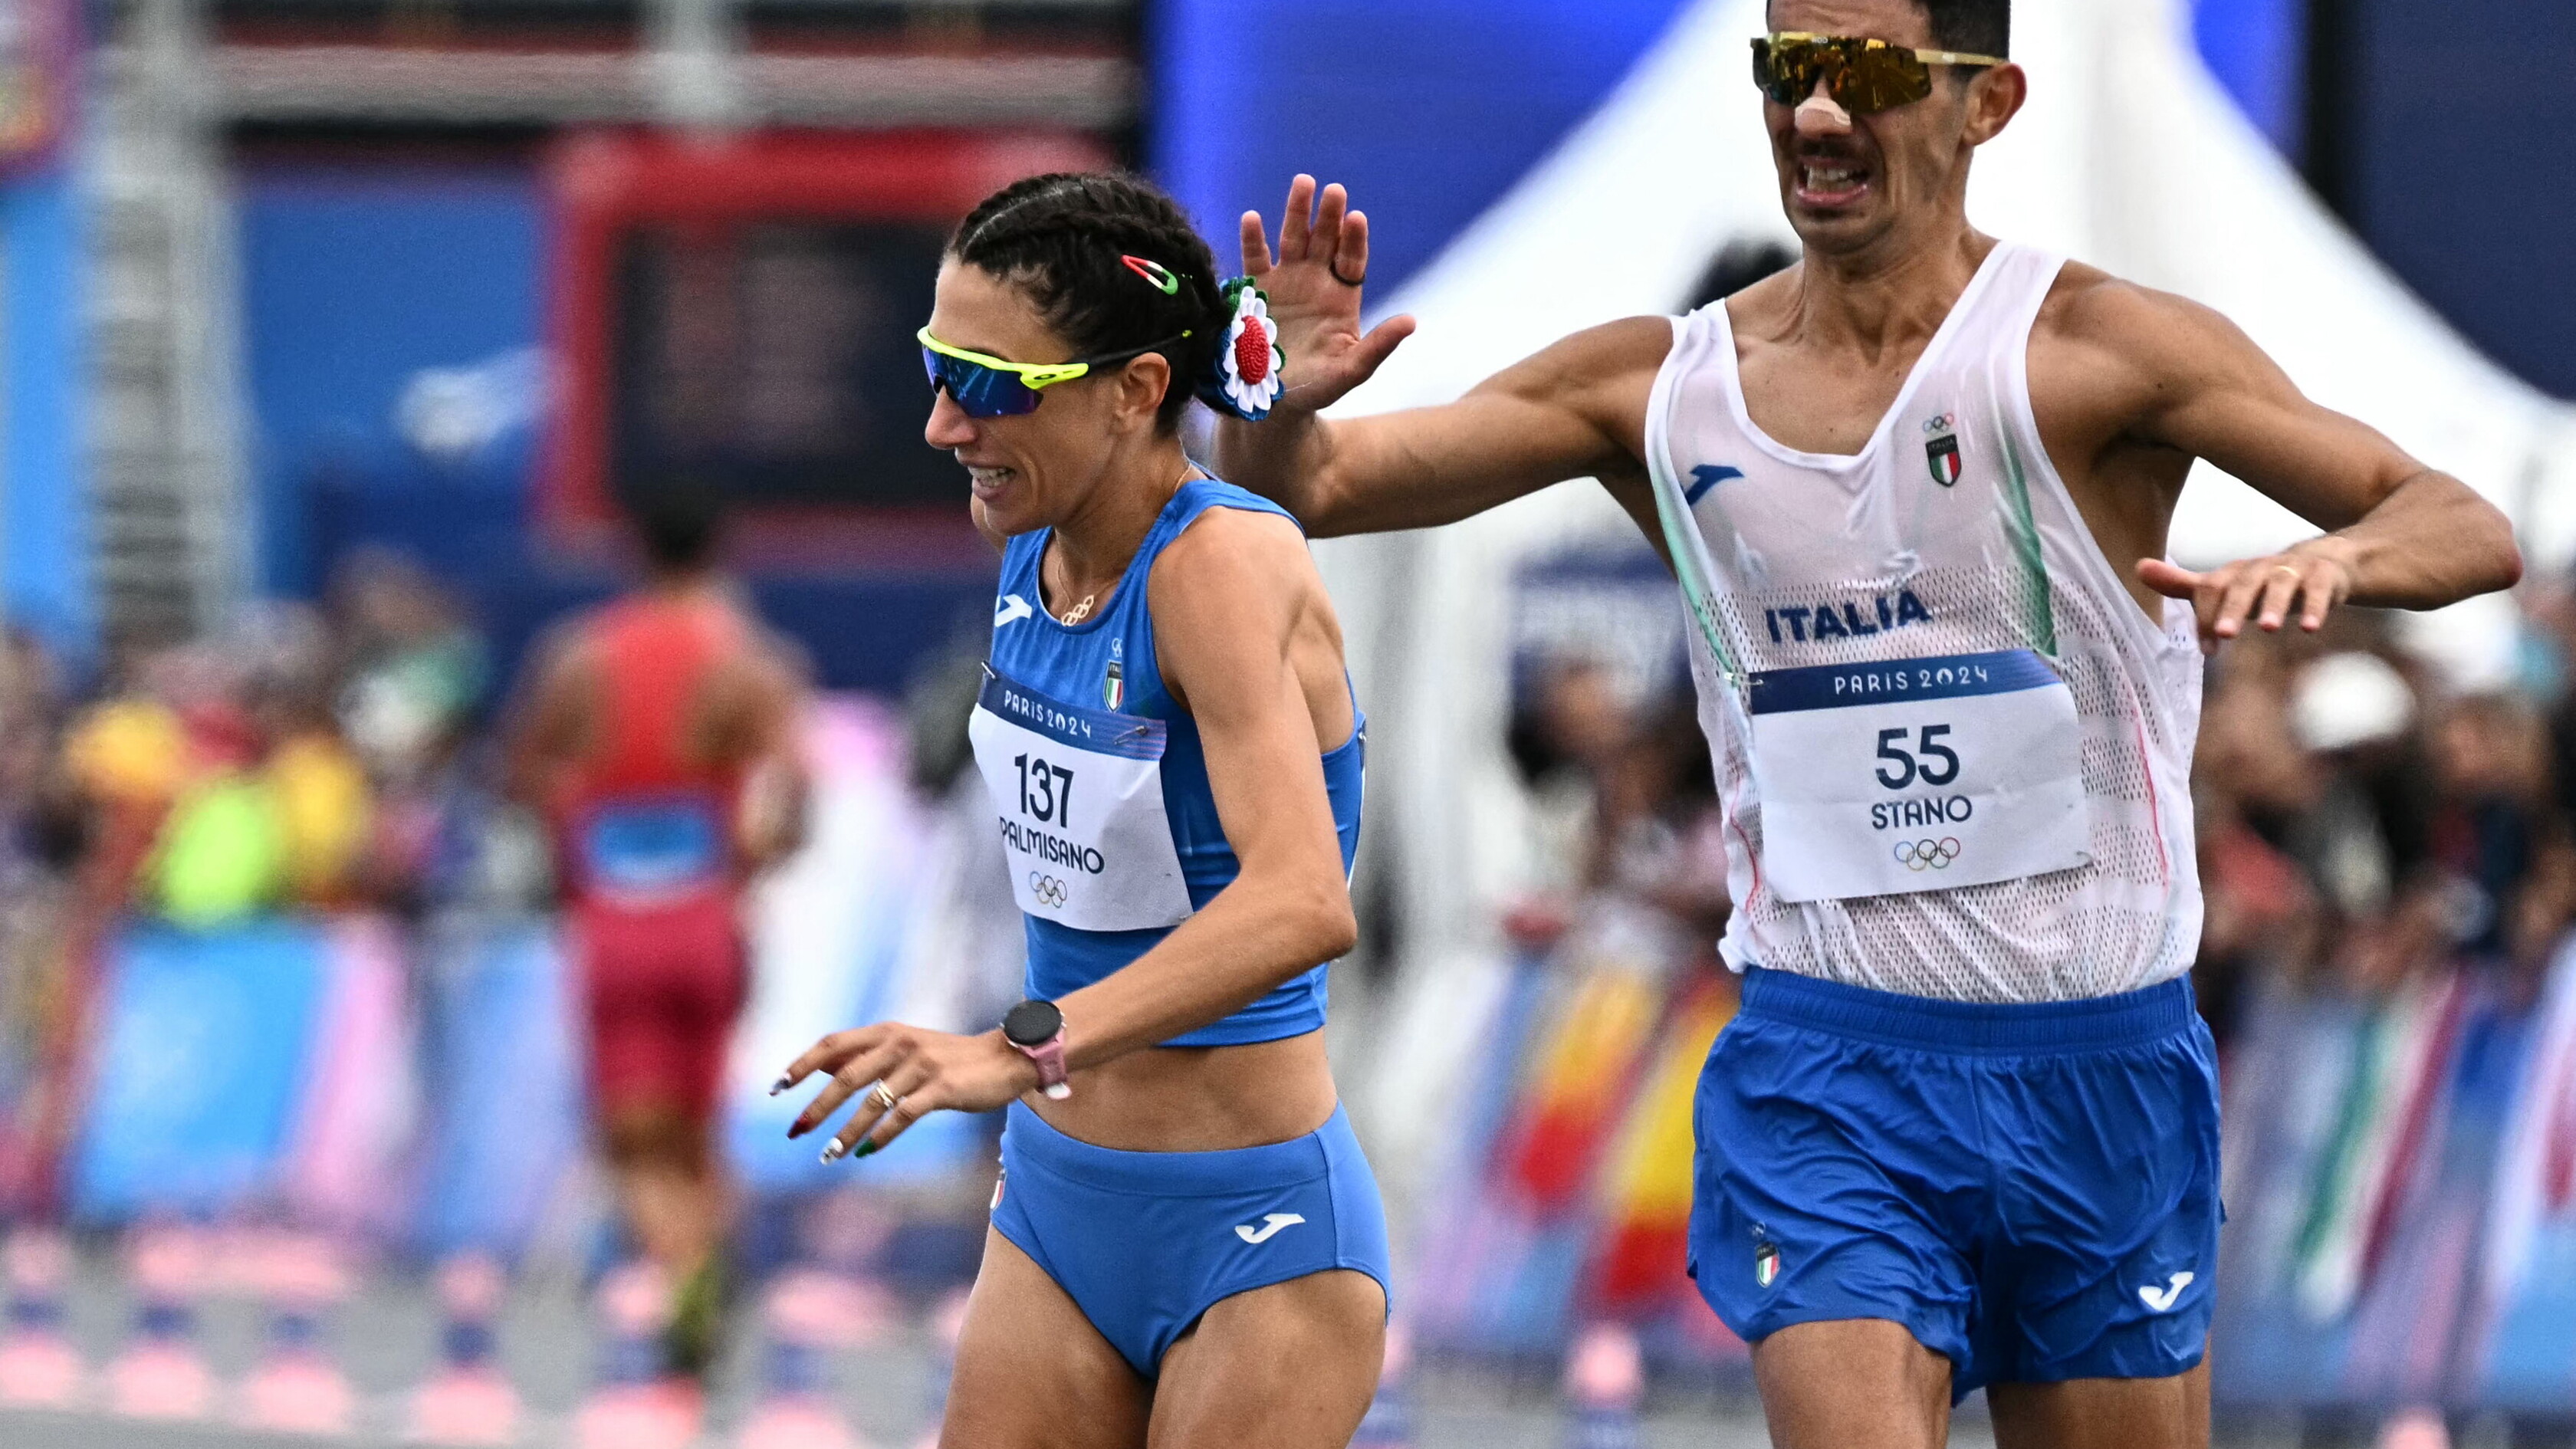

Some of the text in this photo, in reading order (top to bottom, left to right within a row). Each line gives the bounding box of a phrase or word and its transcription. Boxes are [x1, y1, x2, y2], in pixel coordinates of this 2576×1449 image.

[1766, 591, 1932, 643] ITALIA
[1835, 665, 1989, 695] PARIS 2024
[1004, 689, 1091, 738] PARIS 2024
[1875, 724, 1960, 790] 55
[1014, 753, 1074, 829] 137
[1871, 794, 1973, 830] STANO
[999, 816, 1105, 875] PALMISANO
